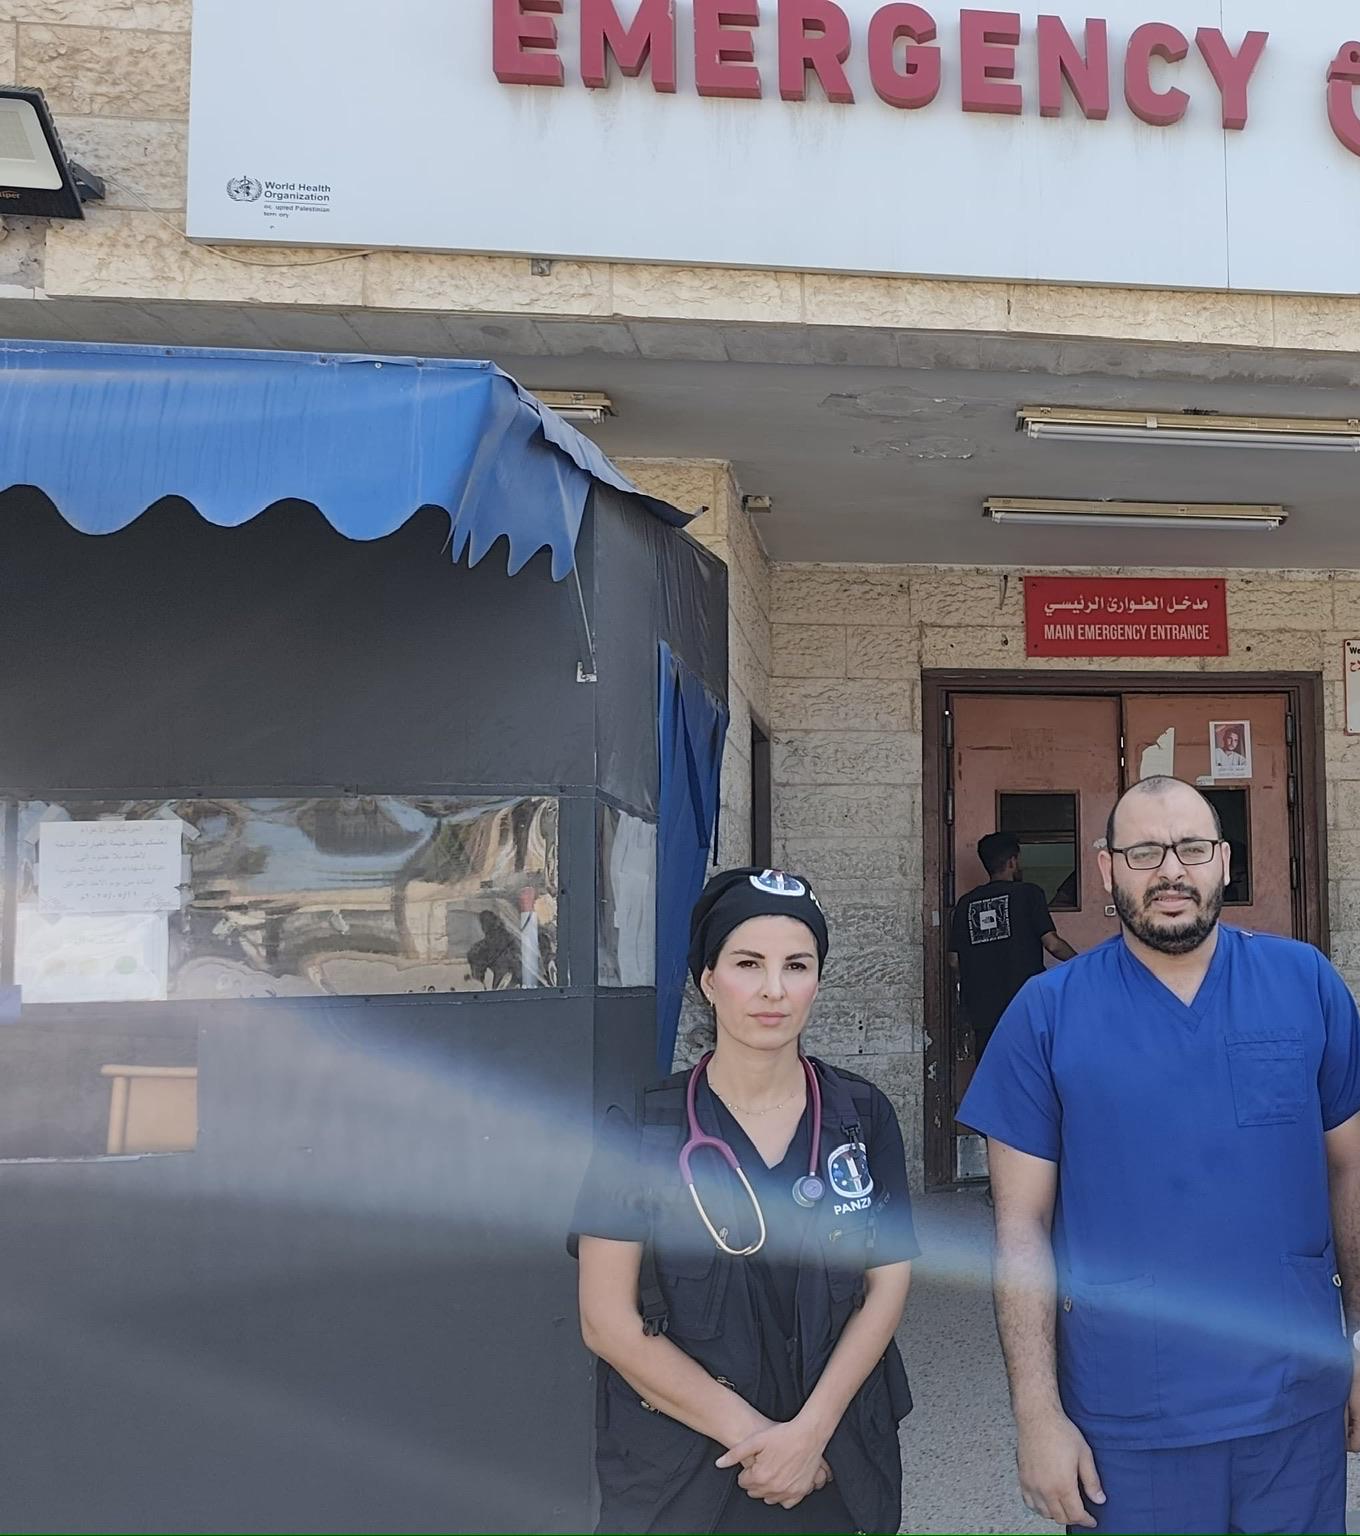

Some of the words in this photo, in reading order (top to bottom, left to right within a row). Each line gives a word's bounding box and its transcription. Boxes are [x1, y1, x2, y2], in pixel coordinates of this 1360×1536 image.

[493, 0, 1269, 130] EMERGENCY
[264, 190, 330, 201] Organization
[265, 181, 295, 190] World
[298, 184, 331, 192] Health
[1044, 595, 1104, 616] الرئيسي
[1107, 595, 1164, 613] الطوارئ
[1166, 595, 1208, 613] مدخل
[1044, 624, 1074, 640] MAIN
[1078, 624, 1147, 640] EMERGENCY
[1150, 624, 1209, 640] ENTRANCE
[833, 1196, 872, 1216] PANZ
